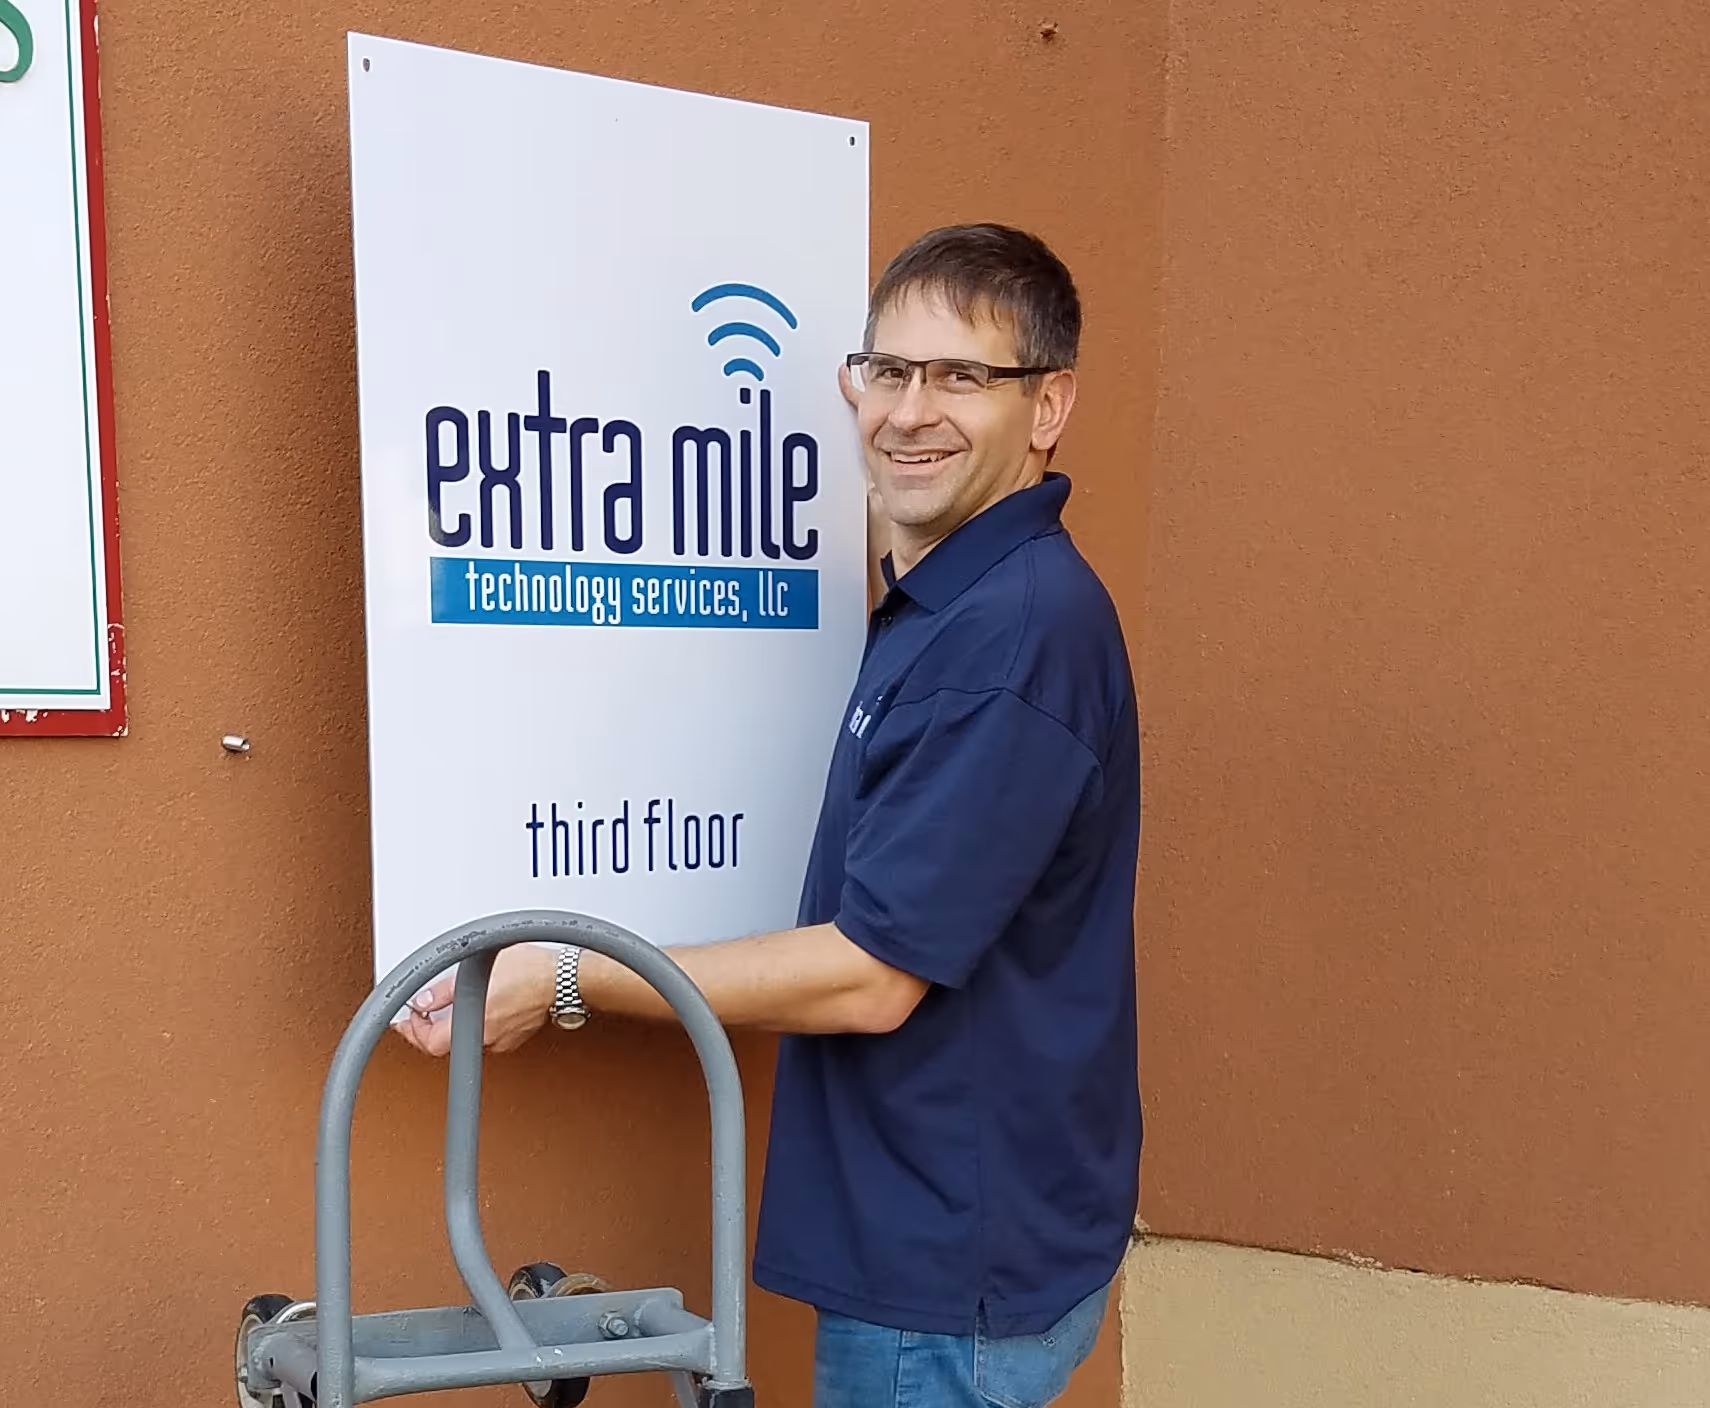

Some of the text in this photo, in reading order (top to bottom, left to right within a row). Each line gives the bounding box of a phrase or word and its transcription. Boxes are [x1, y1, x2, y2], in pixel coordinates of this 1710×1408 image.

[425, 370, 819, 560] extra mile
[466, 561, 789, 624] technology services, llc
[526, 798, 744, 877] third floor
